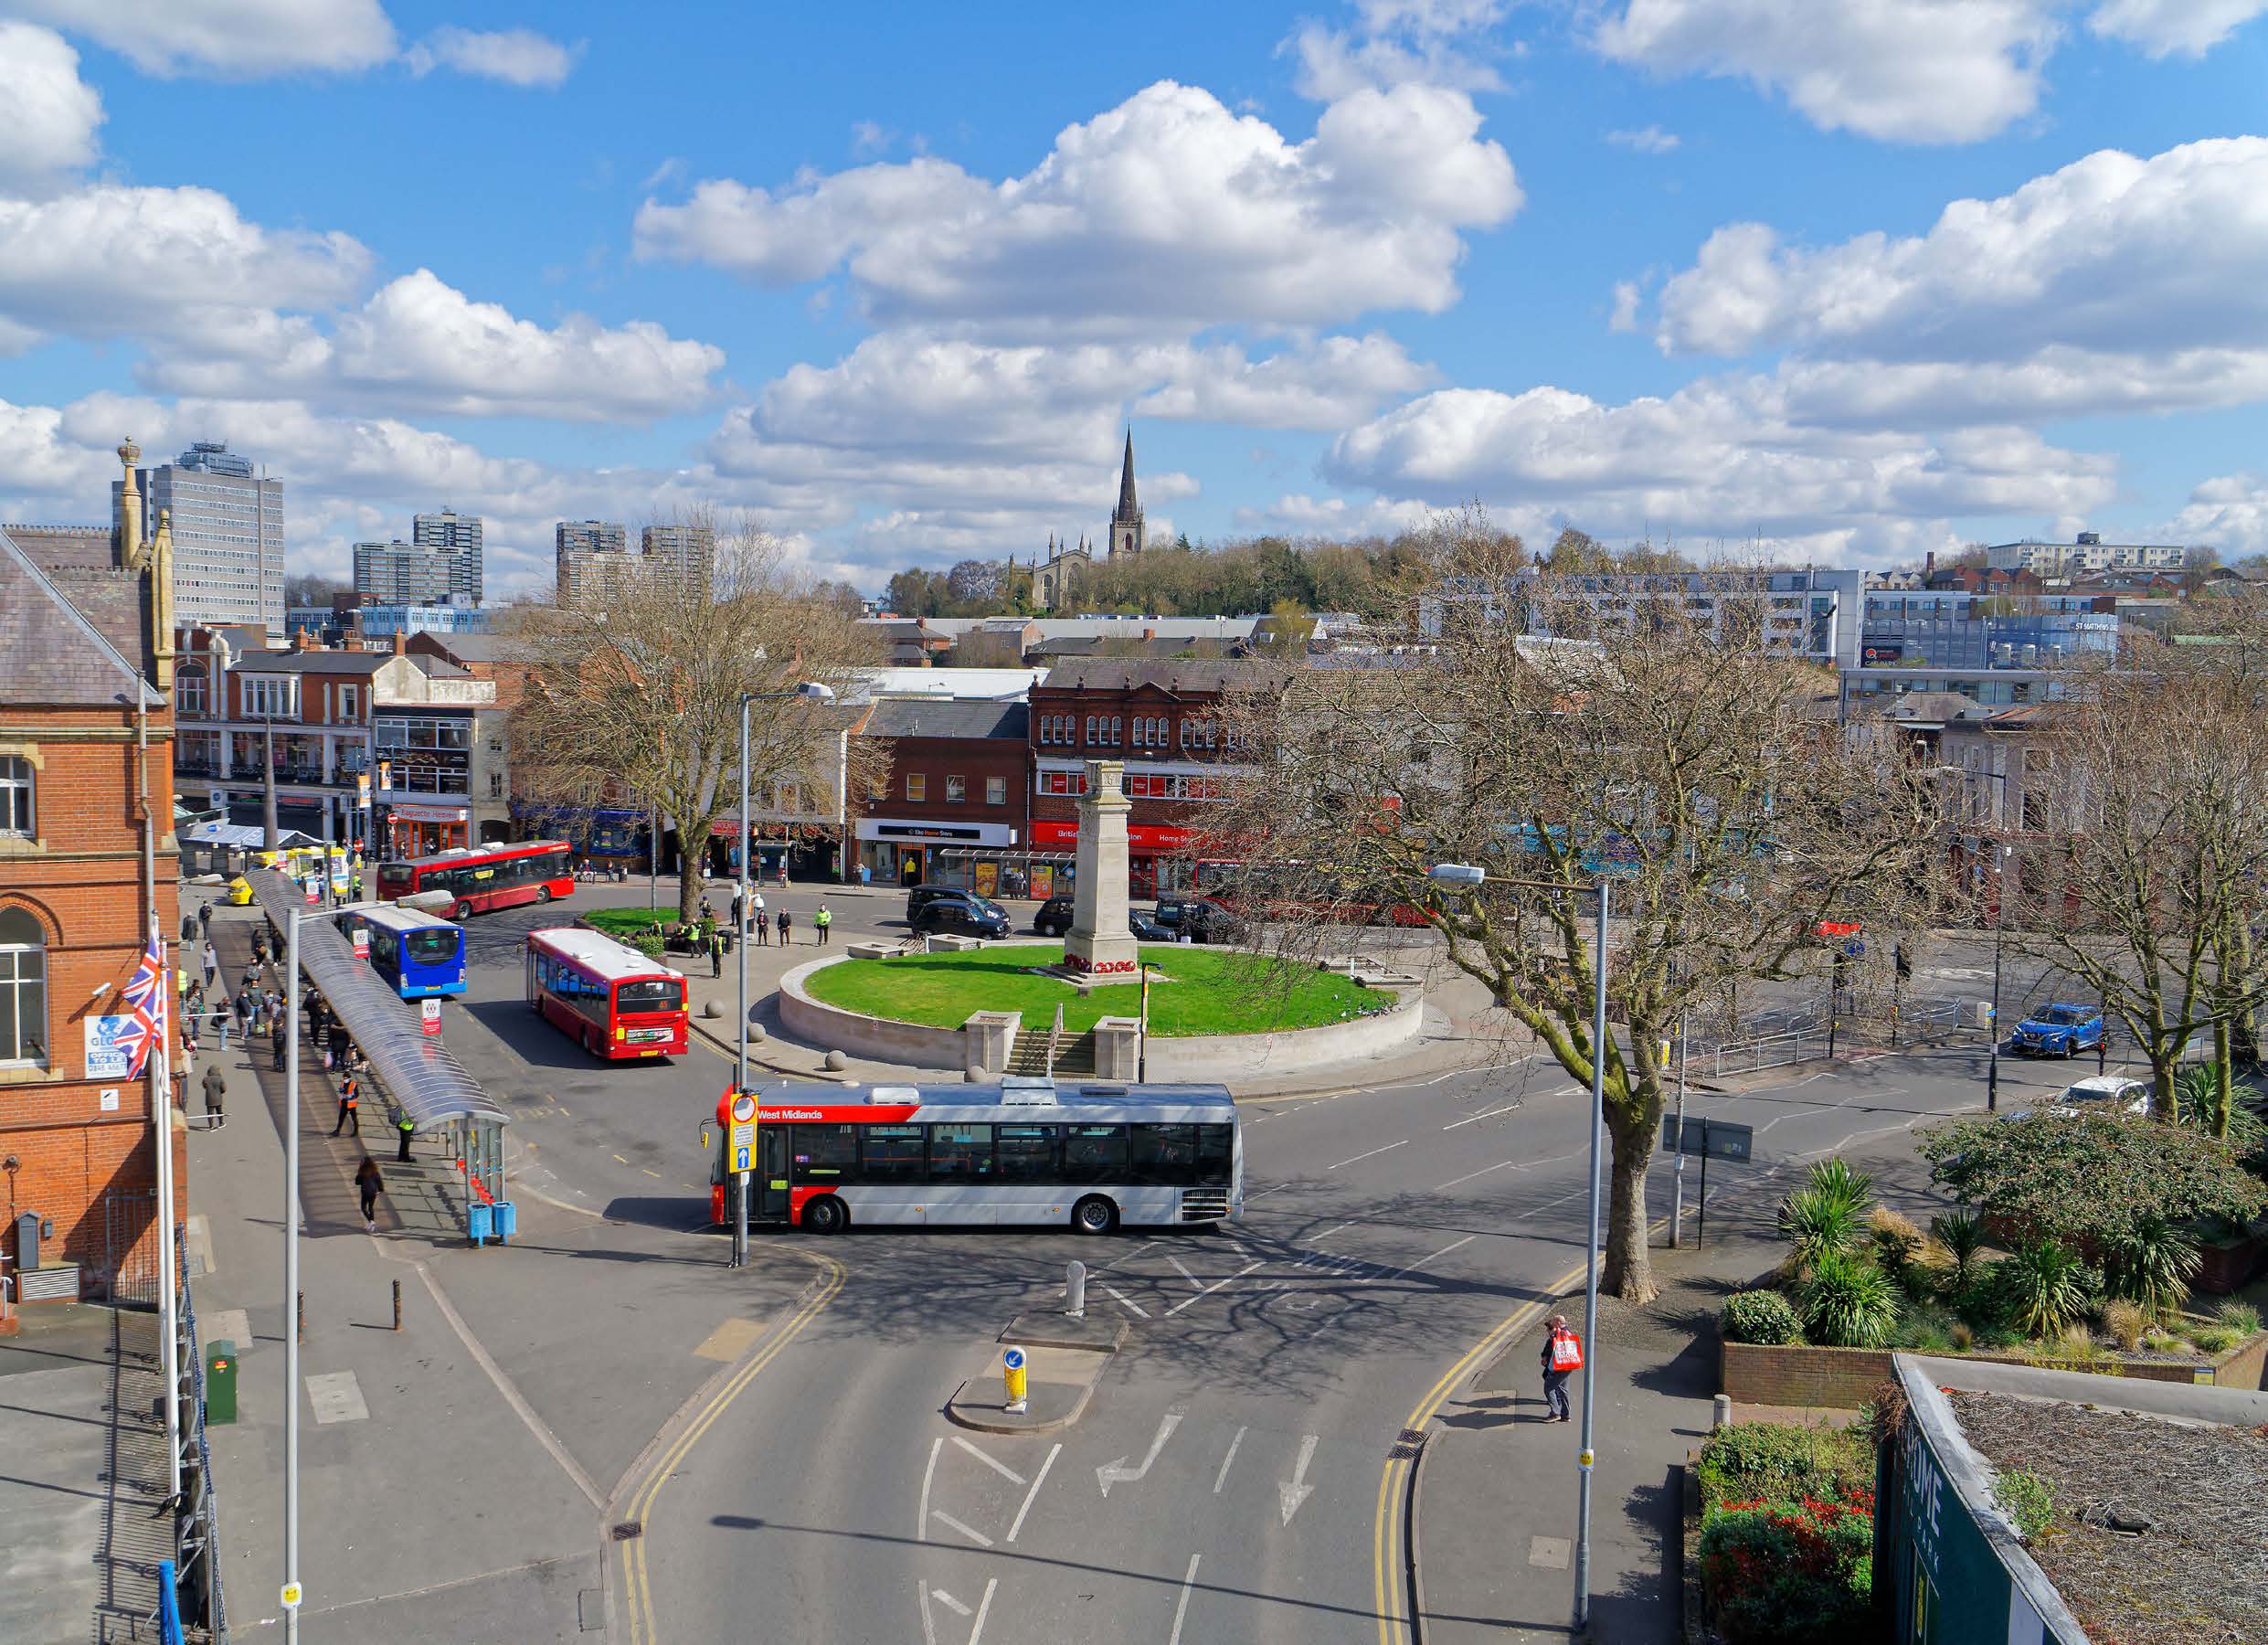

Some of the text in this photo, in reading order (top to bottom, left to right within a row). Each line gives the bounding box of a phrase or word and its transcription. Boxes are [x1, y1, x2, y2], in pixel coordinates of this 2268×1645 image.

[1159, 834, 1179, 843] Home
[758, 1109, 822, 1120] West Midlands
